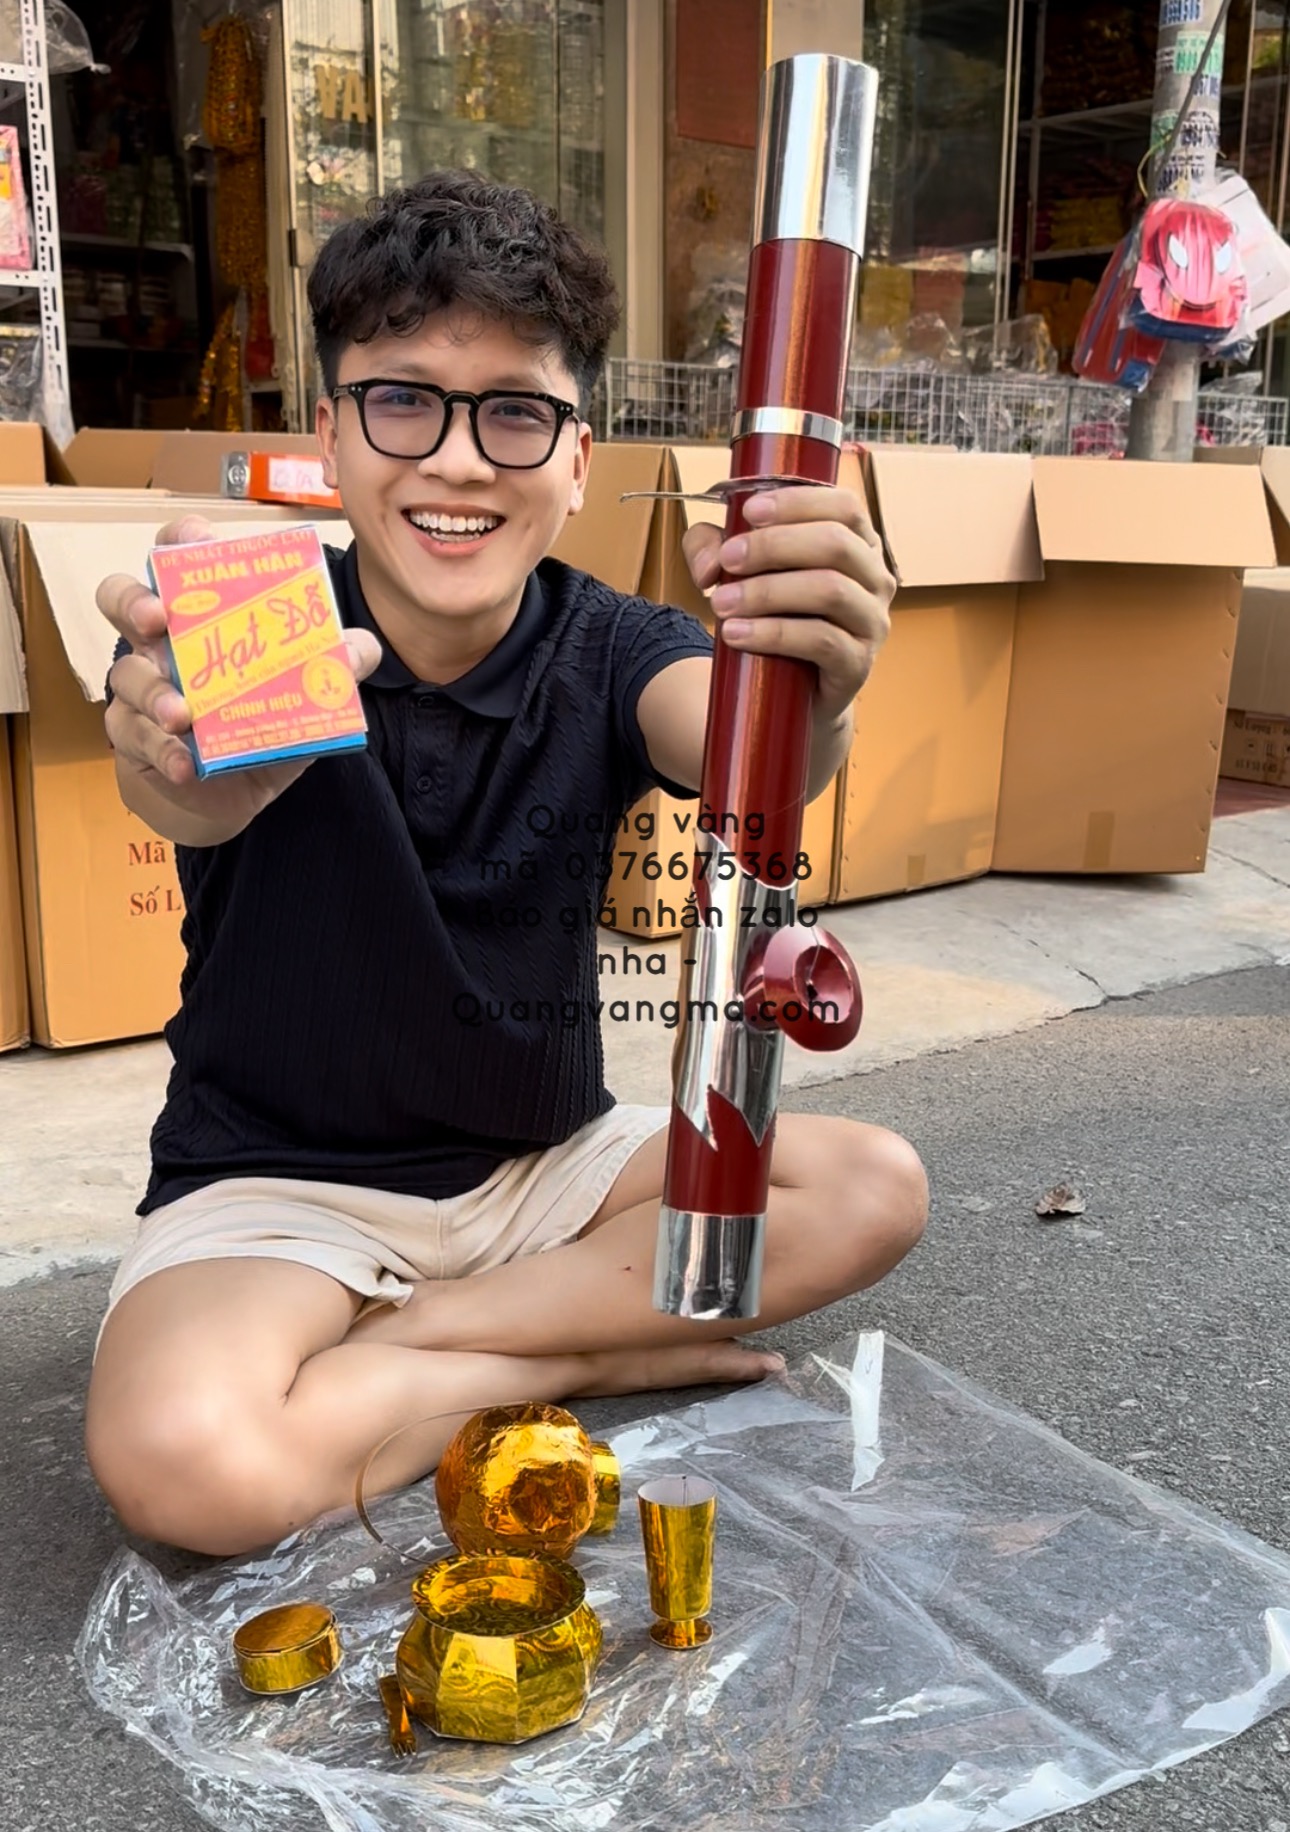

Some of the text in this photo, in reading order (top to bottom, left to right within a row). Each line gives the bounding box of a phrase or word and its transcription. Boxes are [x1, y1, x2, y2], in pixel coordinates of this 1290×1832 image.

[180, 564, 247, 588] XUÂN
[190, 582, 331, 690] Hạt Đỗ
[128, 841, 166, 866] Mã
[130, 885, 161, 916] Số
